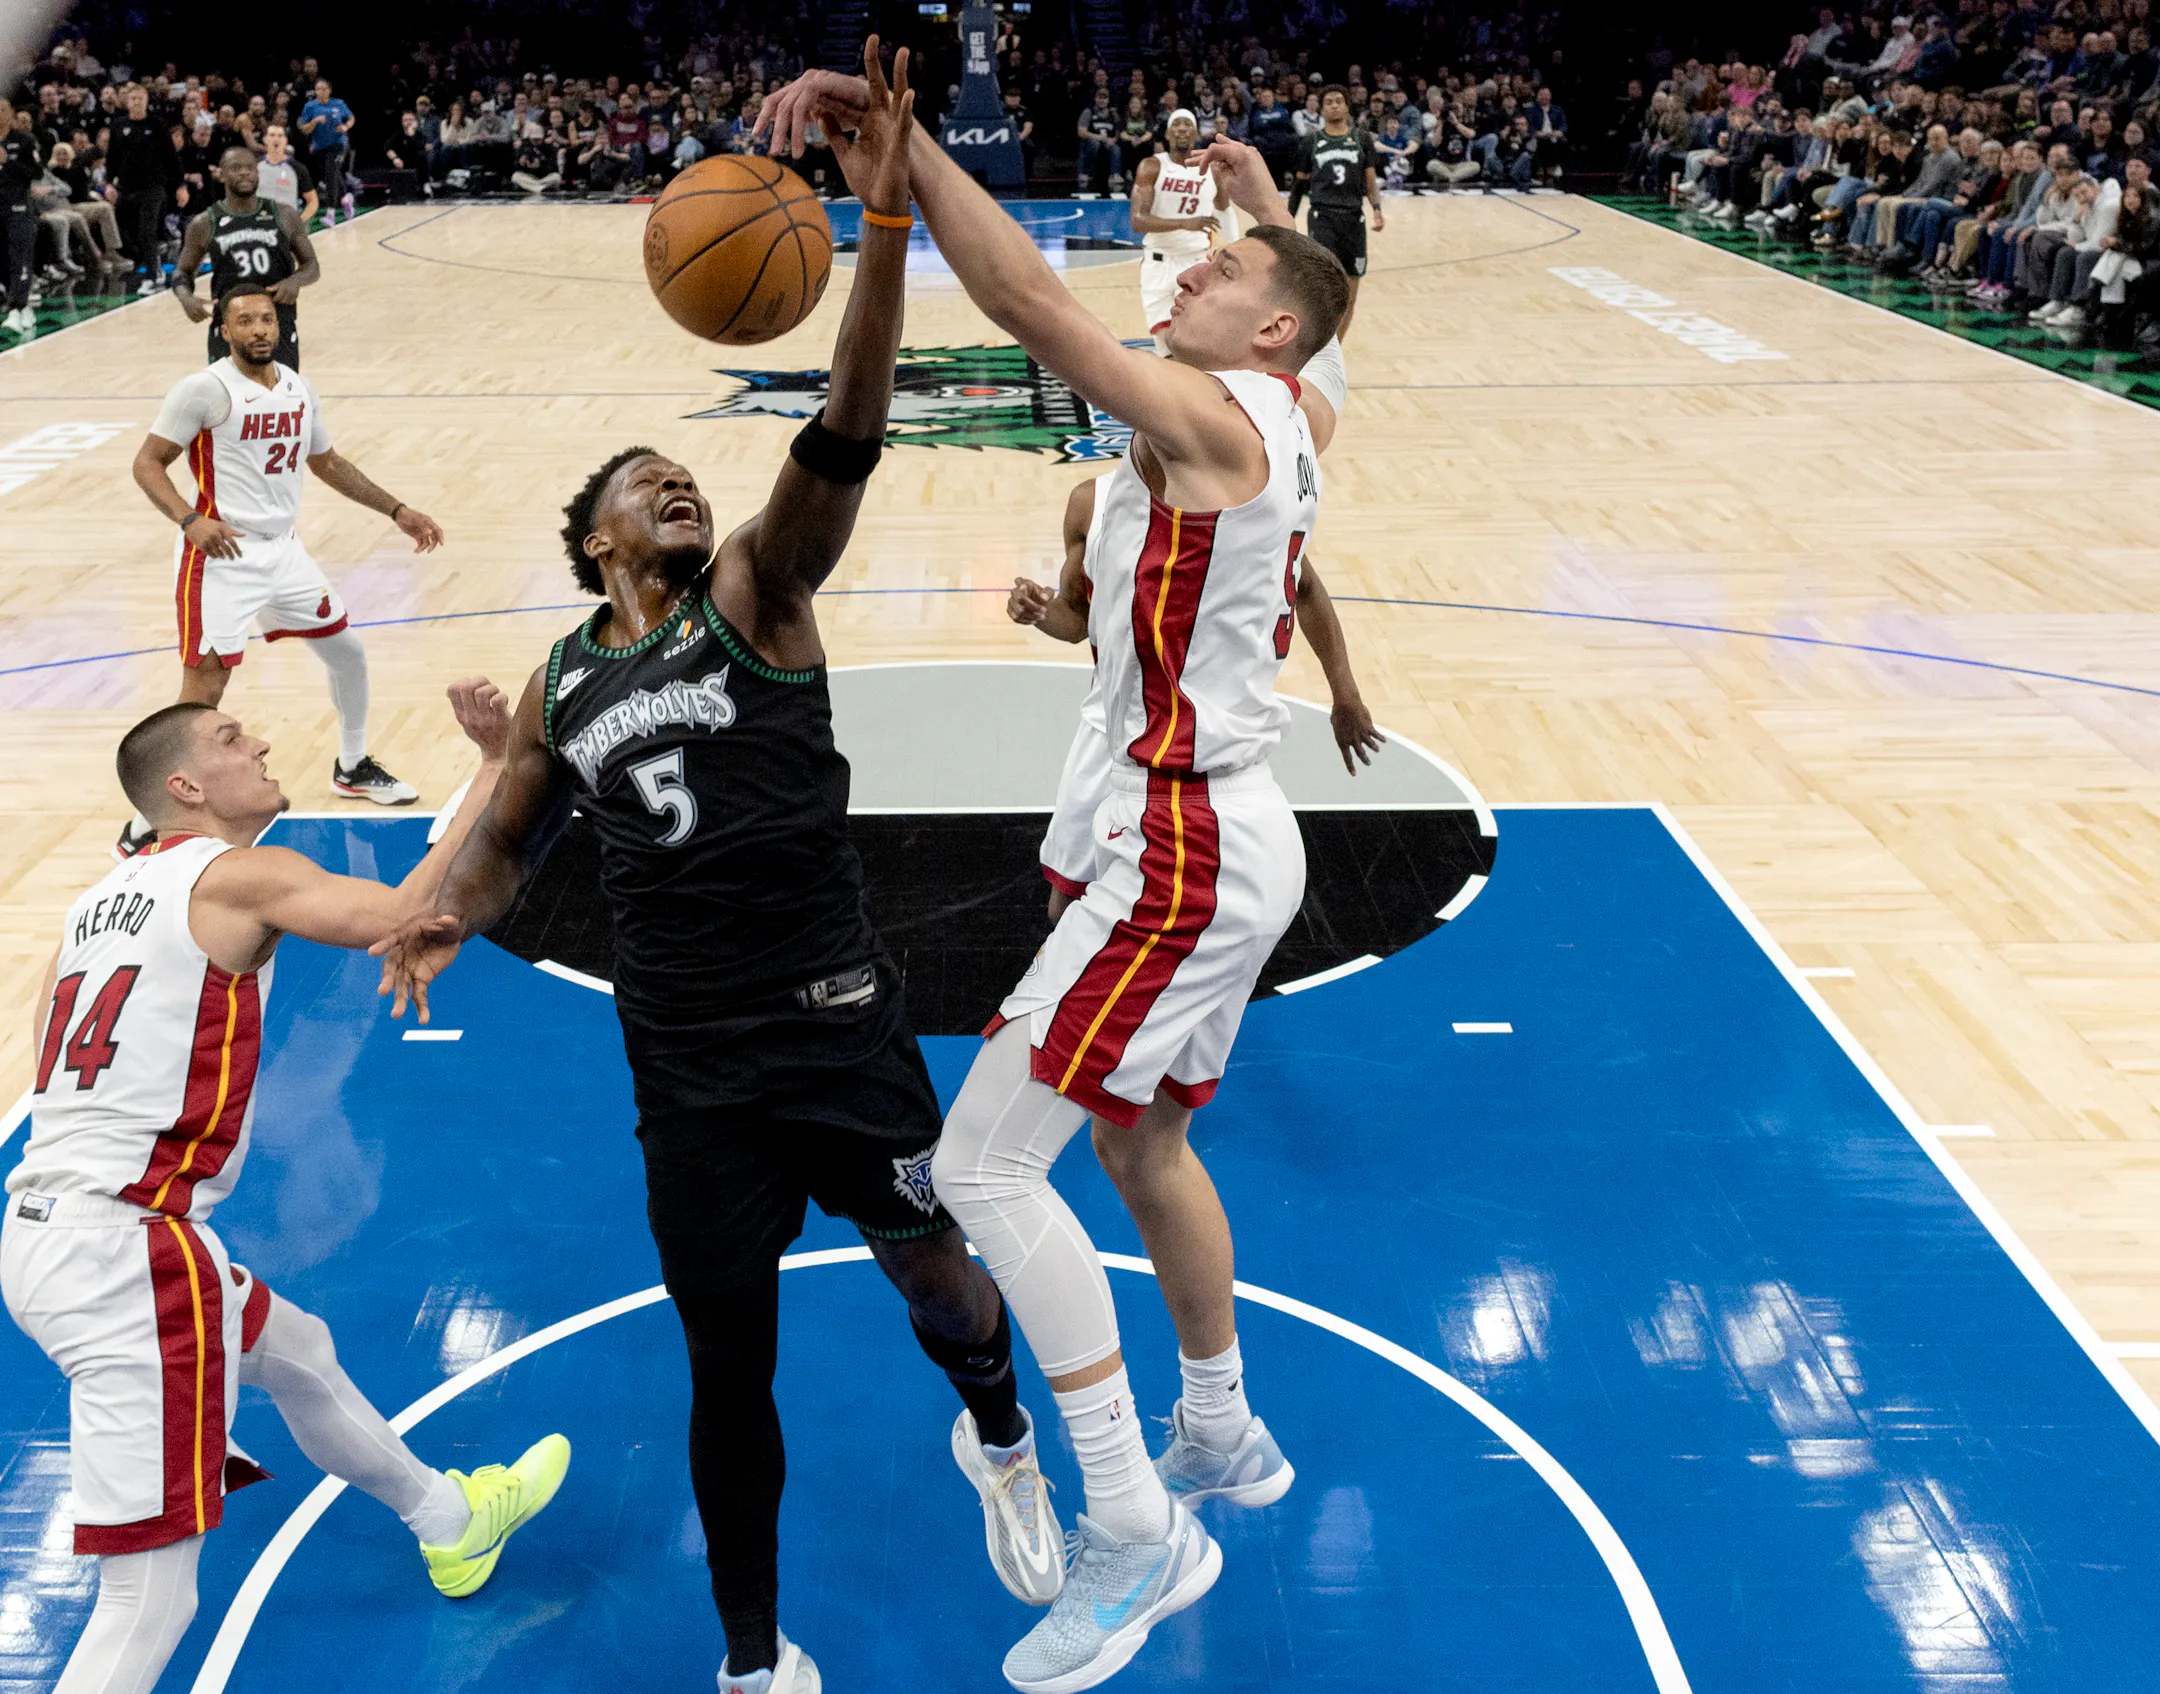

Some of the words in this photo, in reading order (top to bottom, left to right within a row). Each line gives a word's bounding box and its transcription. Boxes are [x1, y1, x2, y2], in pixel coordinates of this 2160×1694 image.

[947, 127, 1010, 145] KIA
[1161, 177, 1206, 195] HEAT
[1332, 164, 1346, 185] 3
[1177, 196, 1200, 215] 13
[231, 247, 270, 277] 30
[240, 403, 305, 441] HEAT
[264, 441, 302, 474] 24
[662, 625, 707, 660] sezzle
[560, 666, 587, 690] NIKE
[558, 662, 737, 797] TIMBERWOLVES
[626, 746, 699, 847] 5
[75, 892, 155, 947] HERRO
[33, 964, 143, 1096] 14
